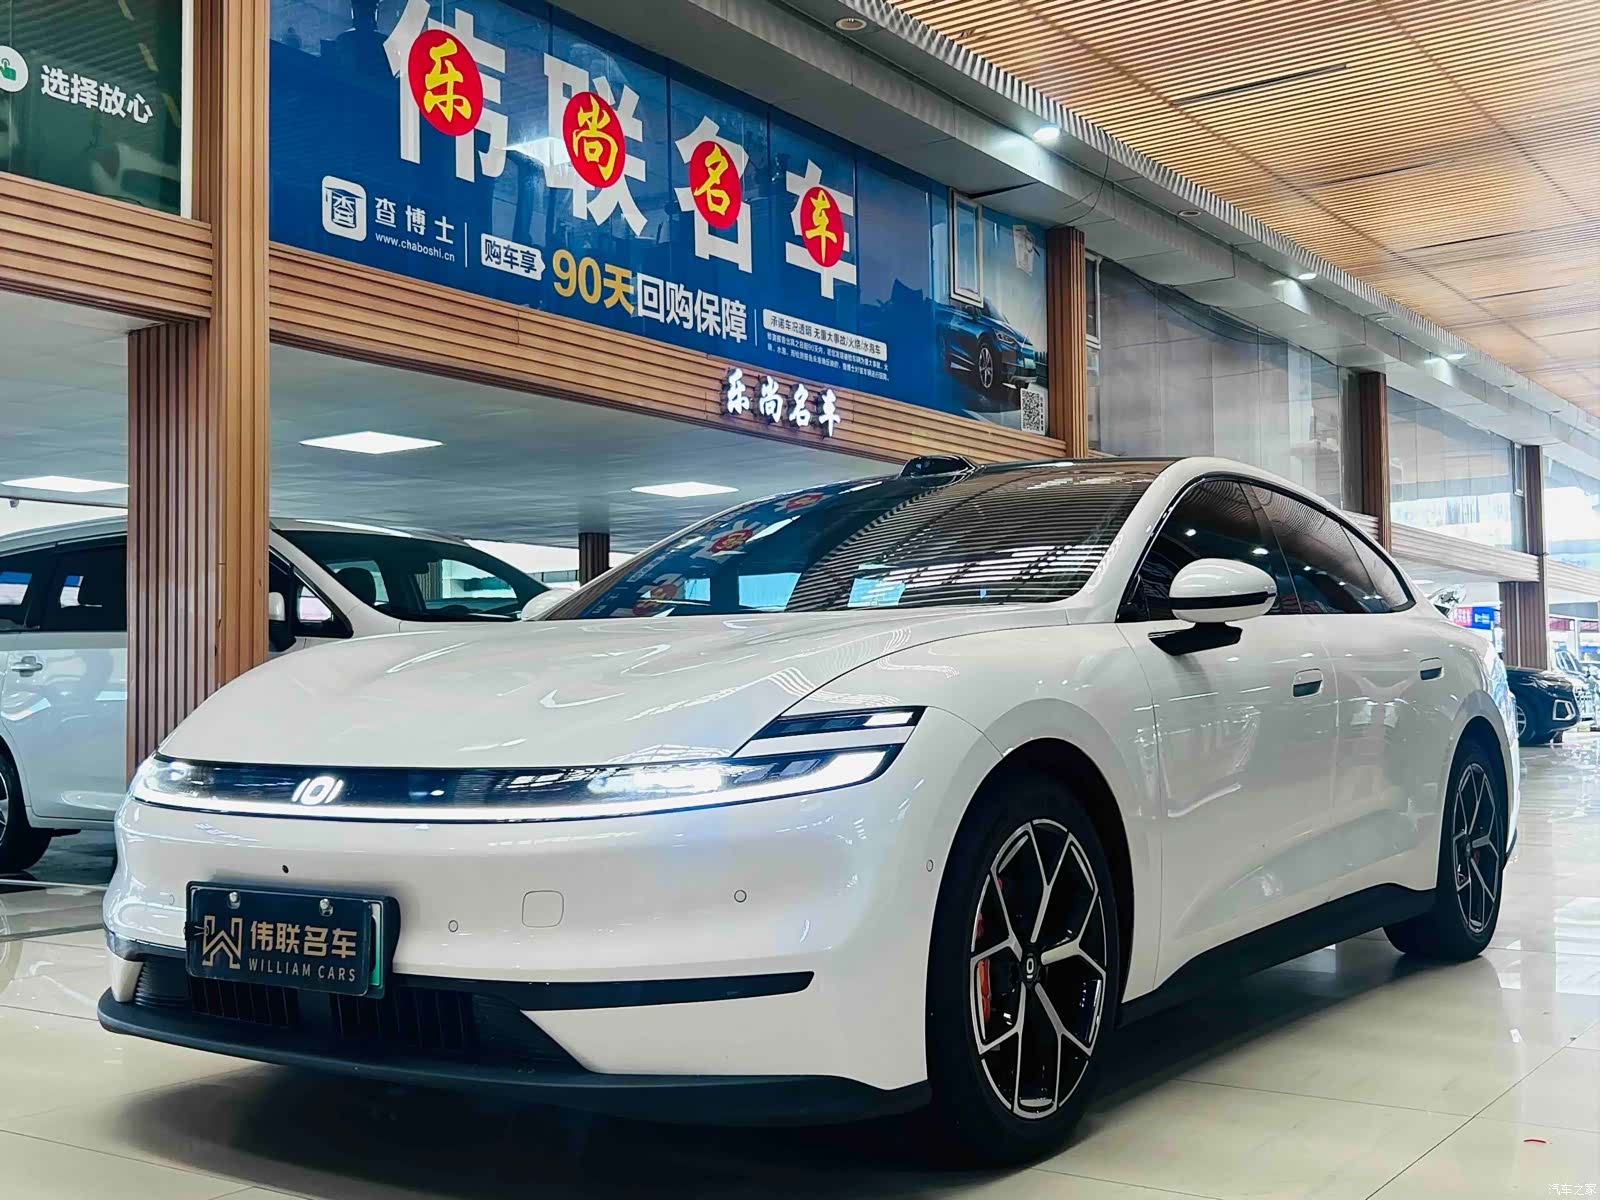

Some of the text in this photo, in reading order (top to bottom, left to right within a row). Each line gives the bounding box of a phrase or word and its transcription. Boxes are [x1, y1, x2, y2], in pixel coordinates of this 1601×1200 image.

[40, 65, 153, 124] 选择放心
[374, 196, 455, 244] 查博士
[375, 232, 455, 262] www.chaboshi.cn
[484, 238, 537, 274] 购车享
[727, 367, 840, 437] 乐尚名车
[250, 920, 358, 959] 伟联名车
[249, 957, 356, 982] WILLIAM CARS
